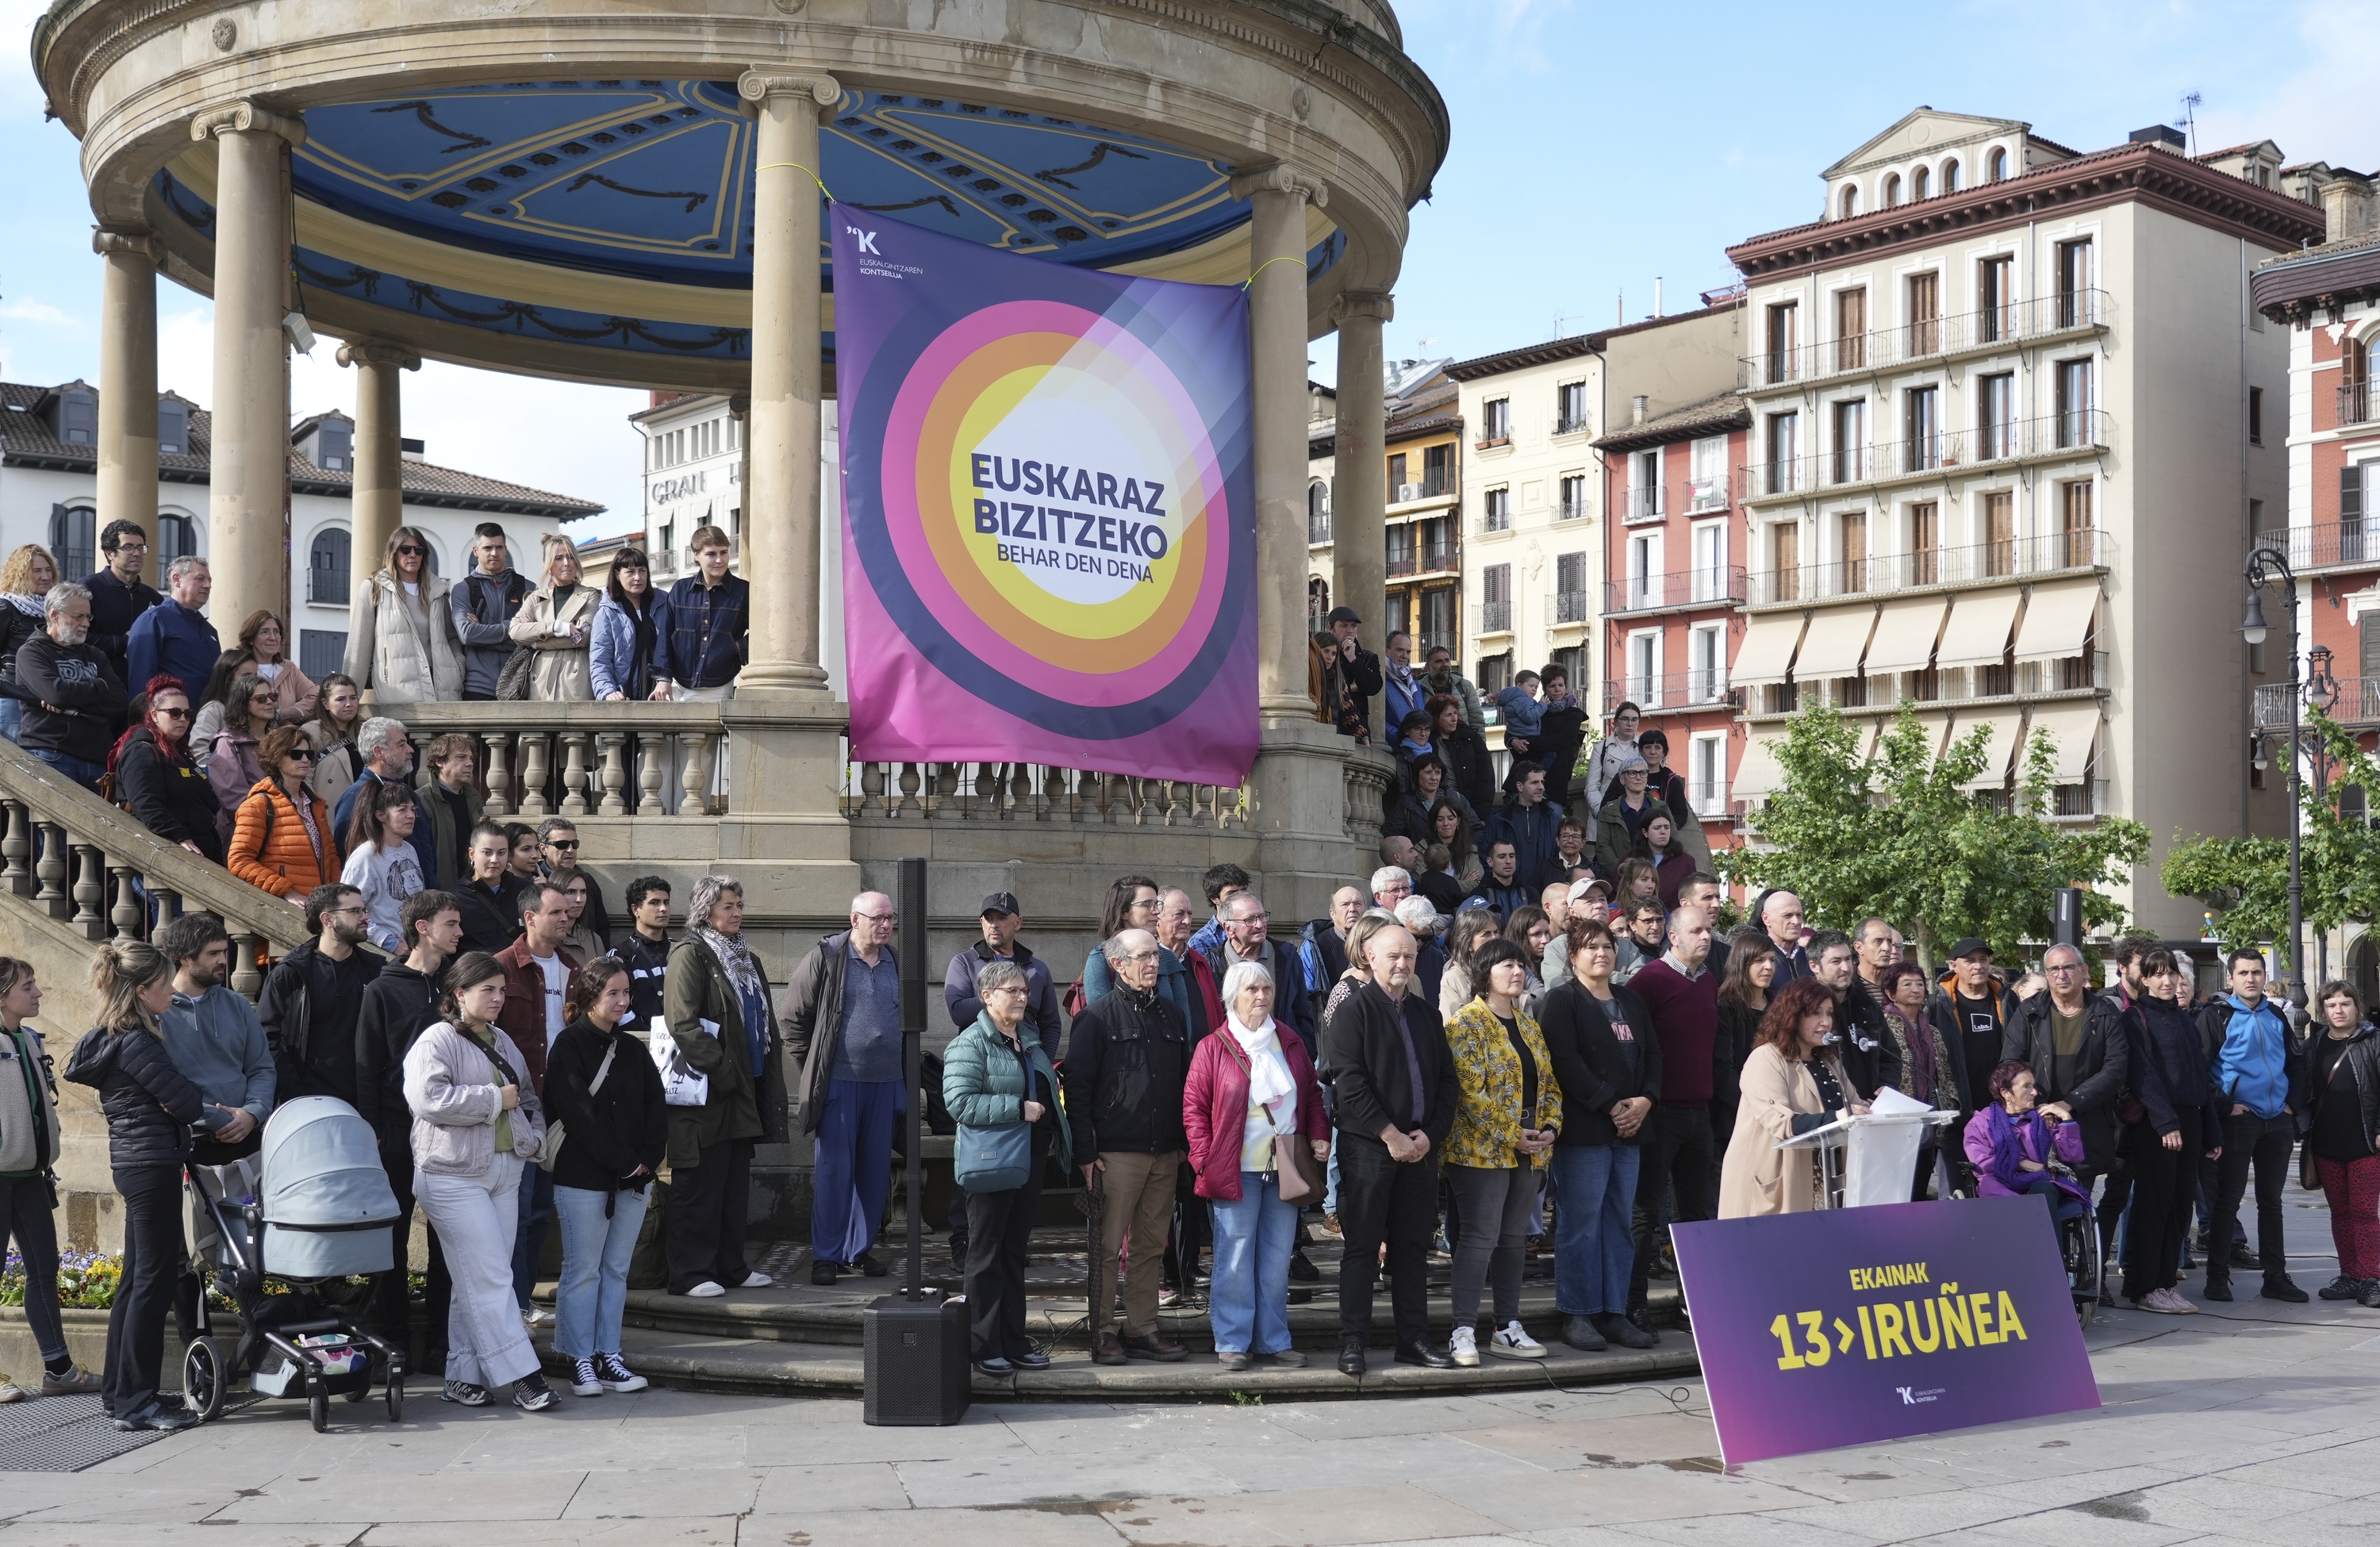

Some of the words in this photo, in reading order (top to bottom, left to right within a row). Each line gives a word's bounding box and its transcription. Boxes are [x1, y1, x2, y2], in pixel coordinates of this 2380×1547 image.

[860, 259, 923, 274] EUSKALGINTZAREN
[860, 267, 903, 280] KONTSEILUA
[652, 470, 707, 505] GRAN
[970, 452, 1166, 517] EUSKARAZ
[973, 497, 1169, 560] BIZITZEKO
[996, 543, 1061, 570] BEHAR
[1065, 552, 1104, 574] DEN
[1107, 559, 1154, 584] DENA
[1849, 1262, 1929, 1291] EKAINAK
[1769, 1310, 1831, 1371] 13
[1856, 1281, 2028, 1360] IRUÑEA
